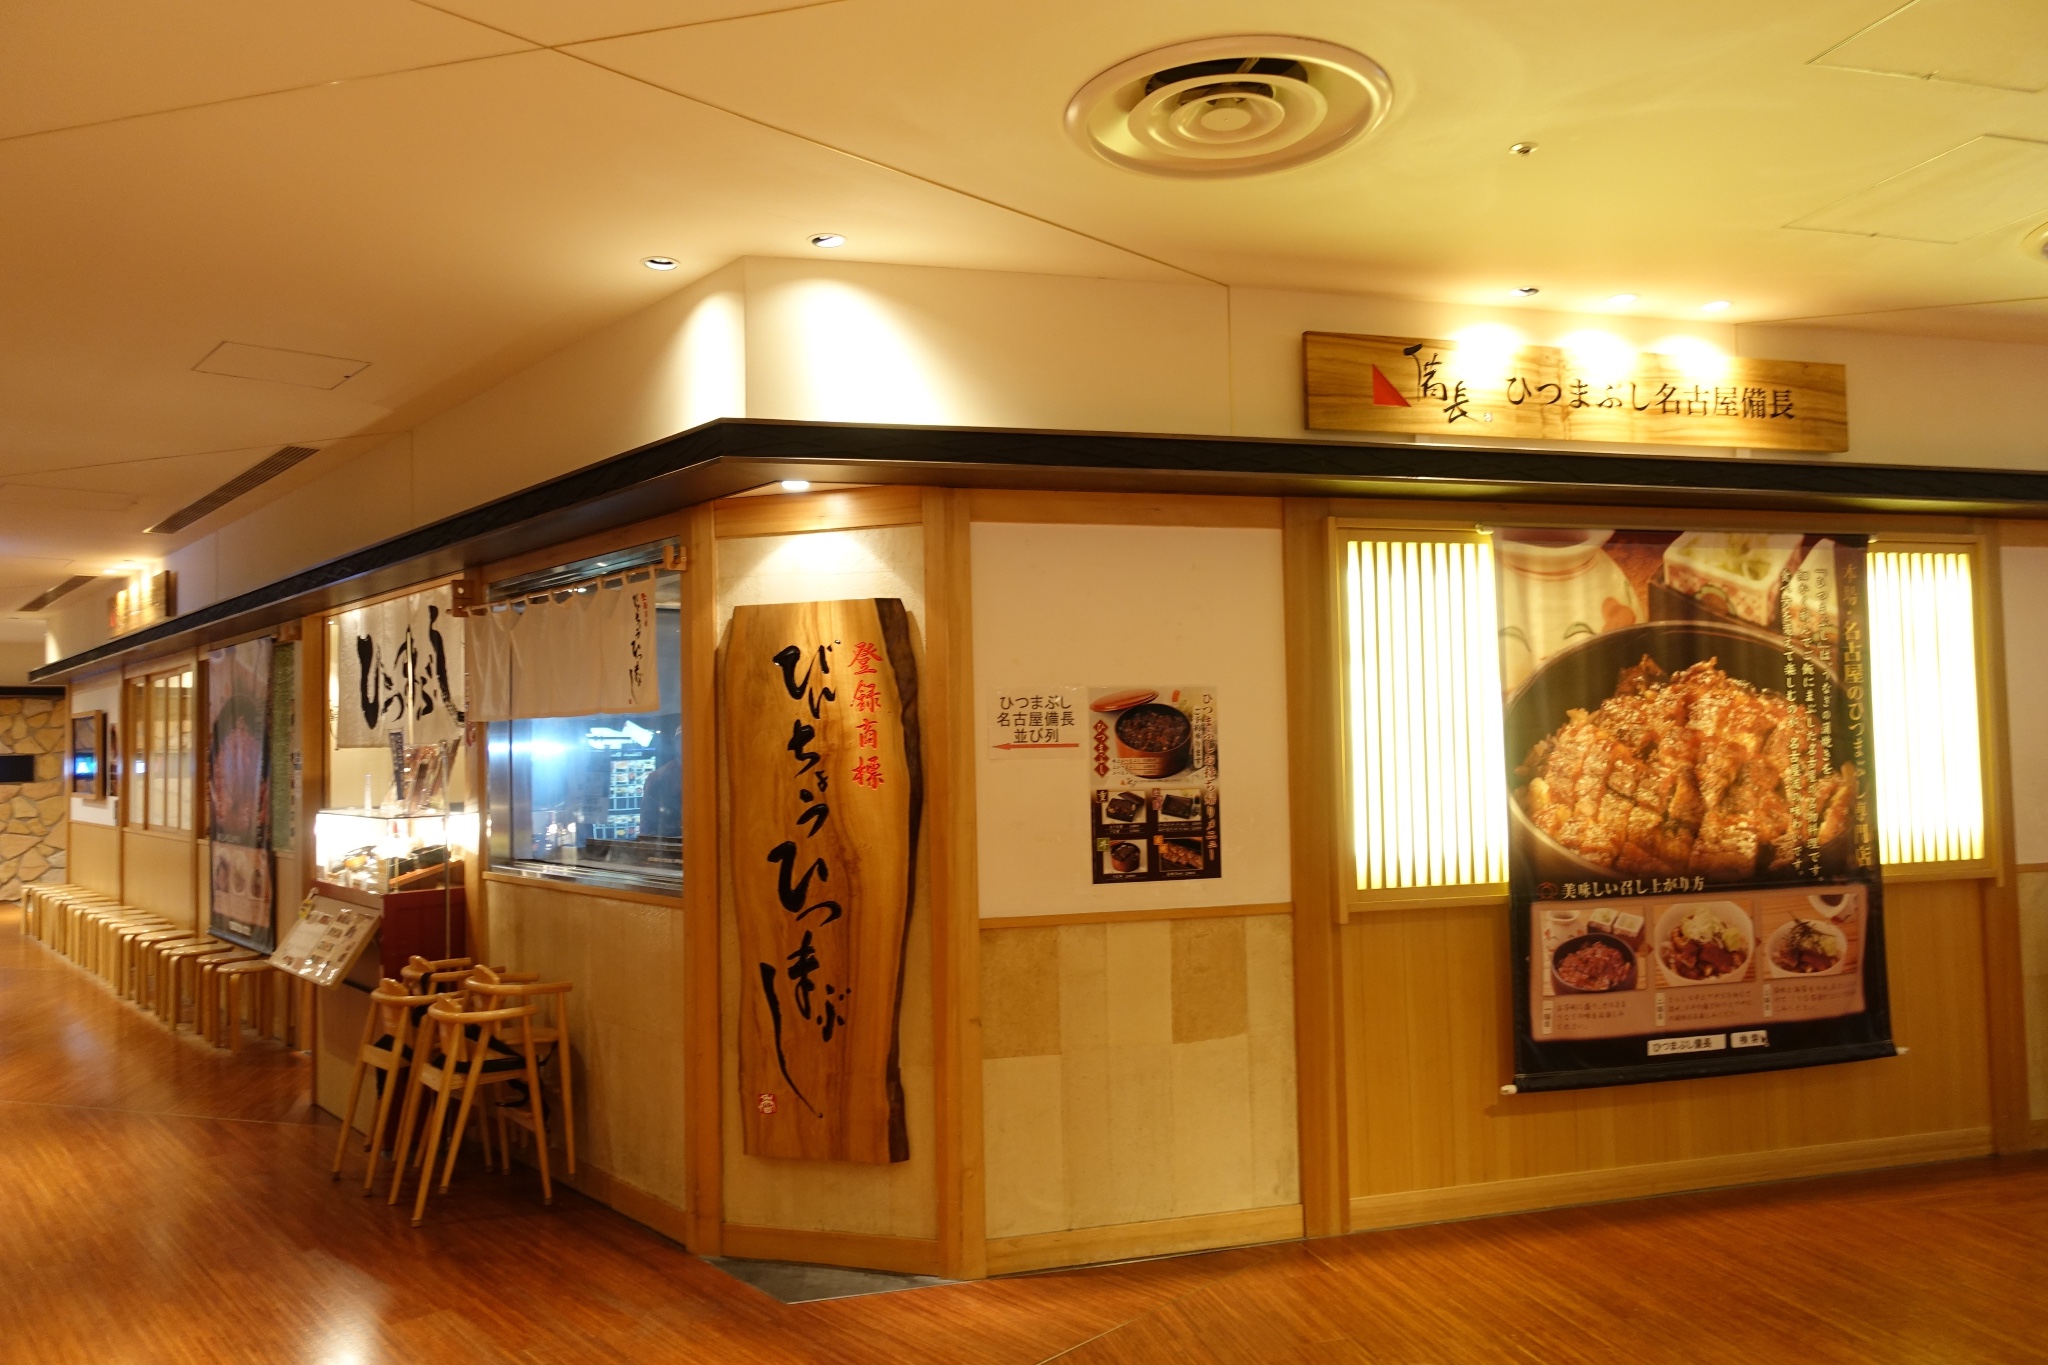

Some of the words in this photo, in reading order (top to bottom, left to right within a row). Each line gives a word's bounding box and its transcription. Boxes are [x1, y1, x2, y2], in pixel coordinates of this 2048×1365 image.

[1506, 376, 1797, 421] ひつまぶし名古屋備長
[999, 694, 1072, 711] ひつまぶし
[849, 640, 884, 791] 登録商標
[996, 710, 1076, 728] 名古屋備長
[1013, 727, 1060, 744] 並び列
[1561, 875, 1705, 900] 美味しい召し上がり方
